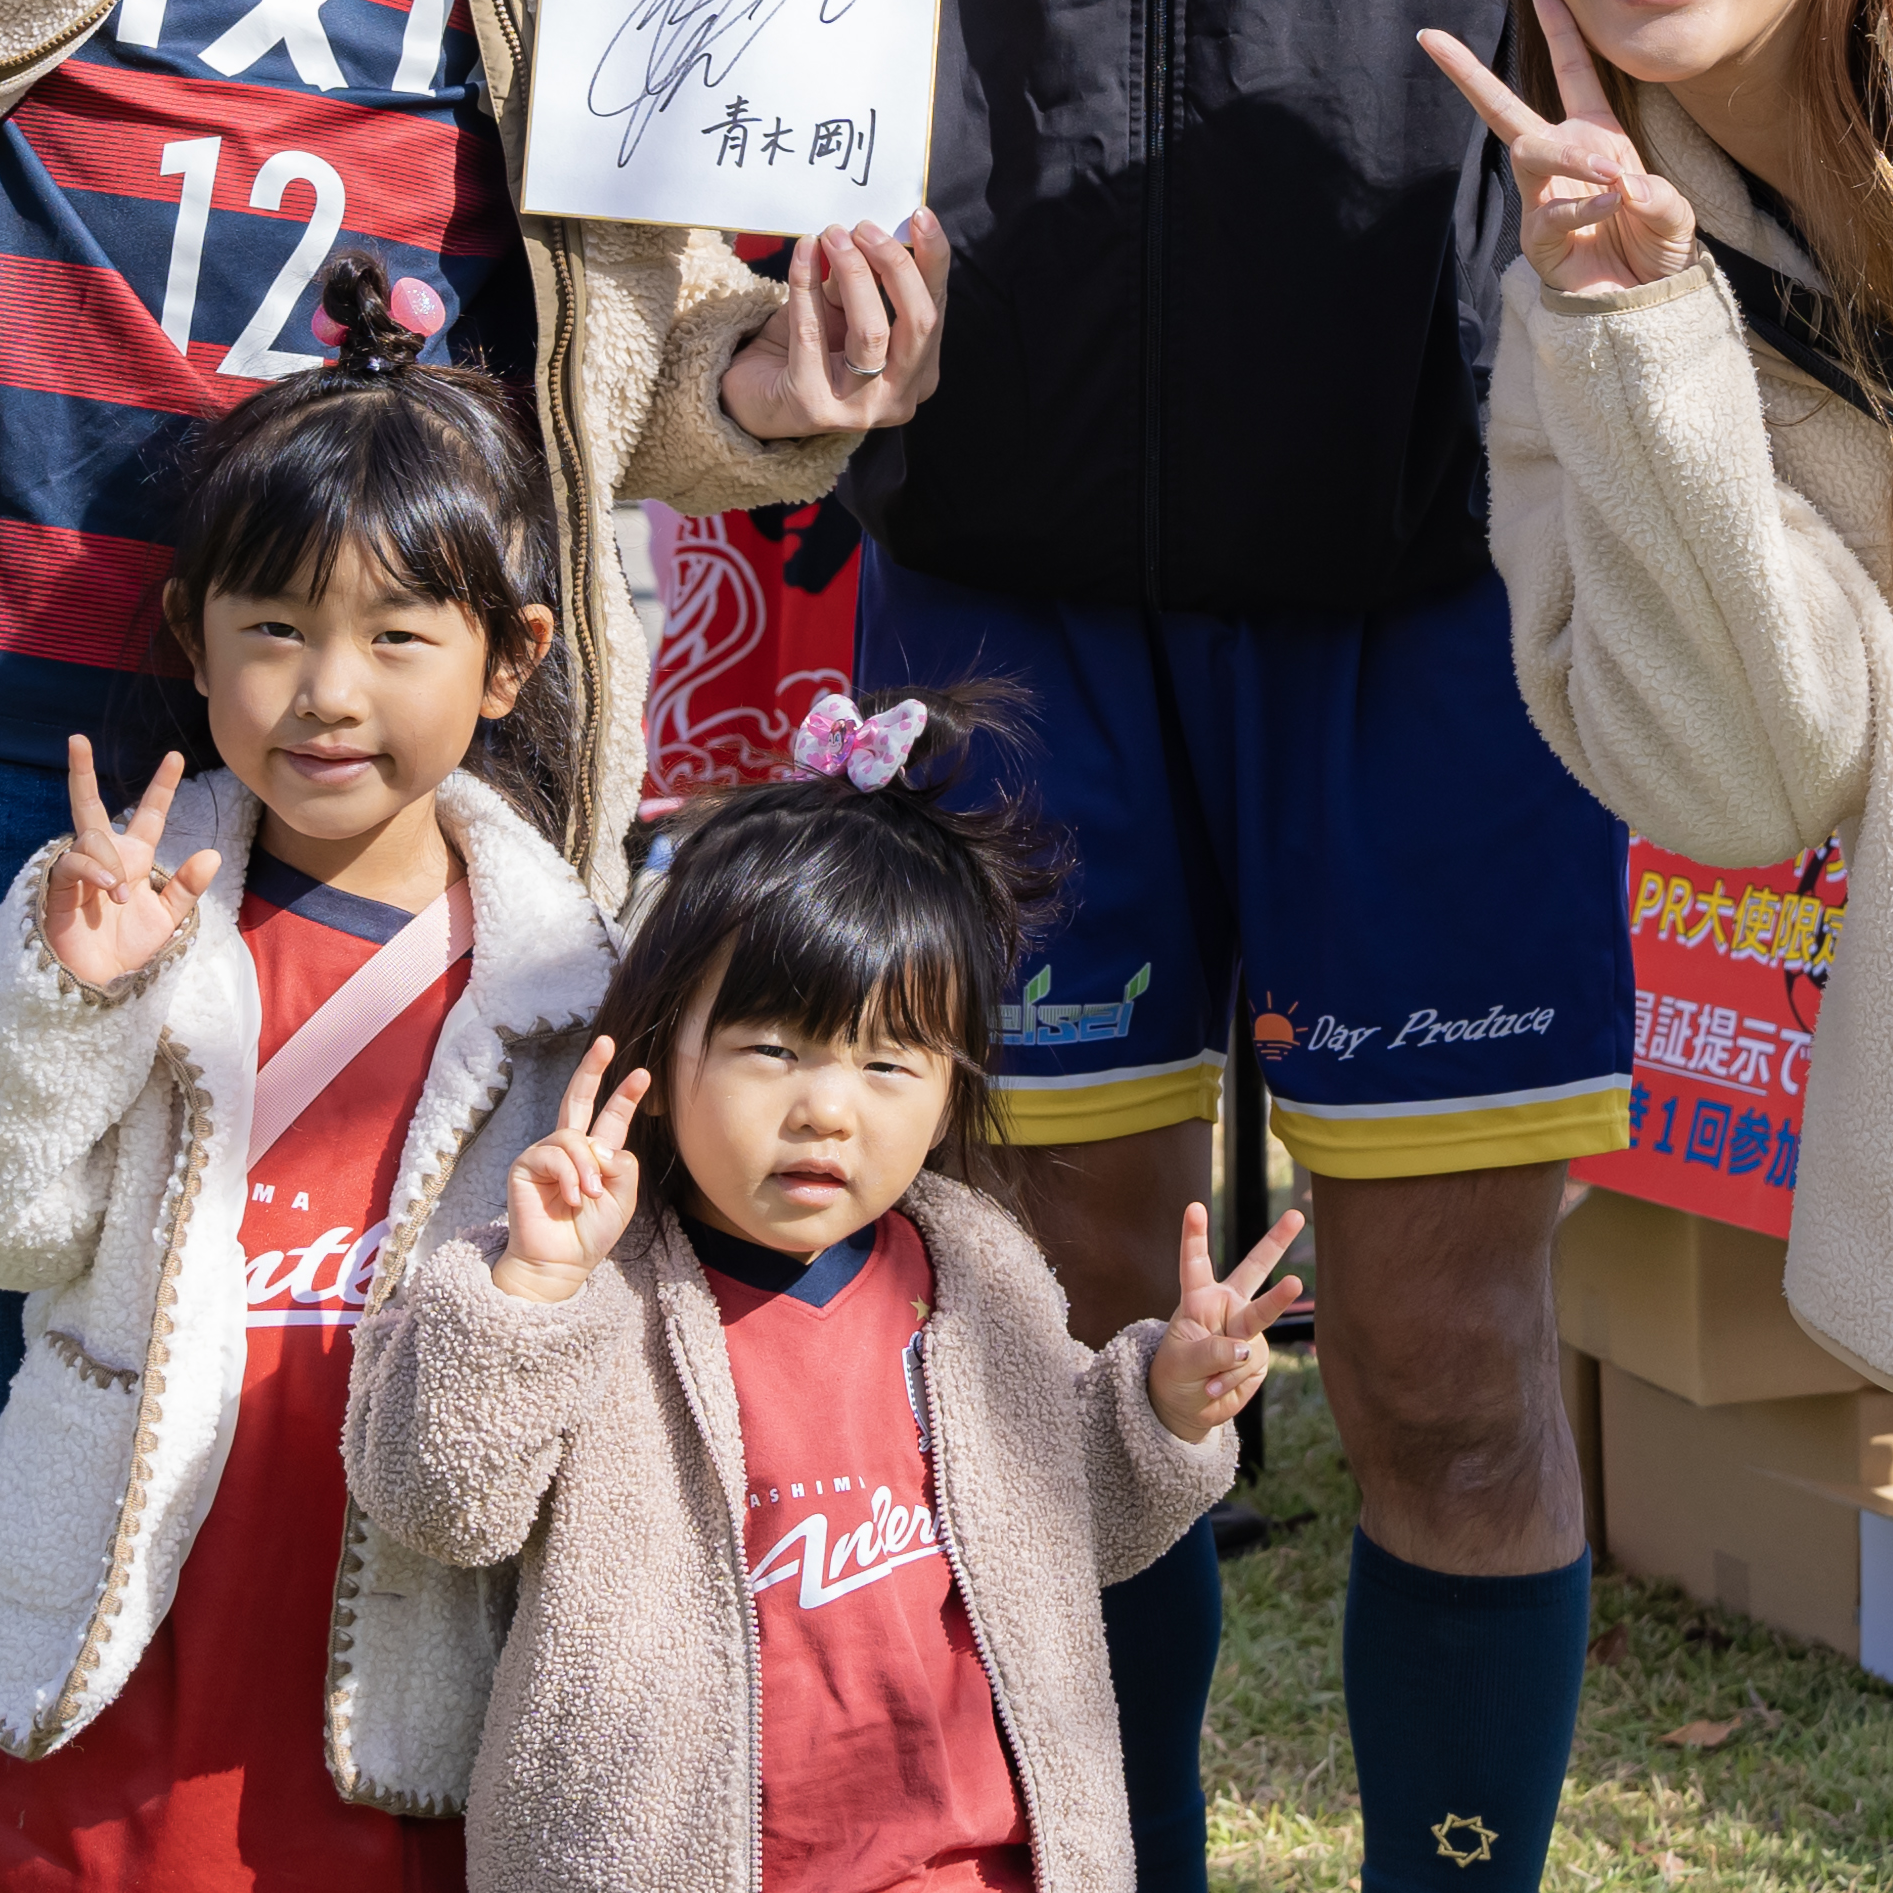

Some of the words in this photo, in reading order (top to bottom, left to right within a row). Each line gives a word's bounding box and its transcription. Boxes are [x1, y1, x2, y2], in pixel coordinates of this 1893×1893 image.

[160, 136, 346, 381] 12
[1307, 1015, 1382, 1061] Day
[1386, 1005, 1556, 1051] Produce
